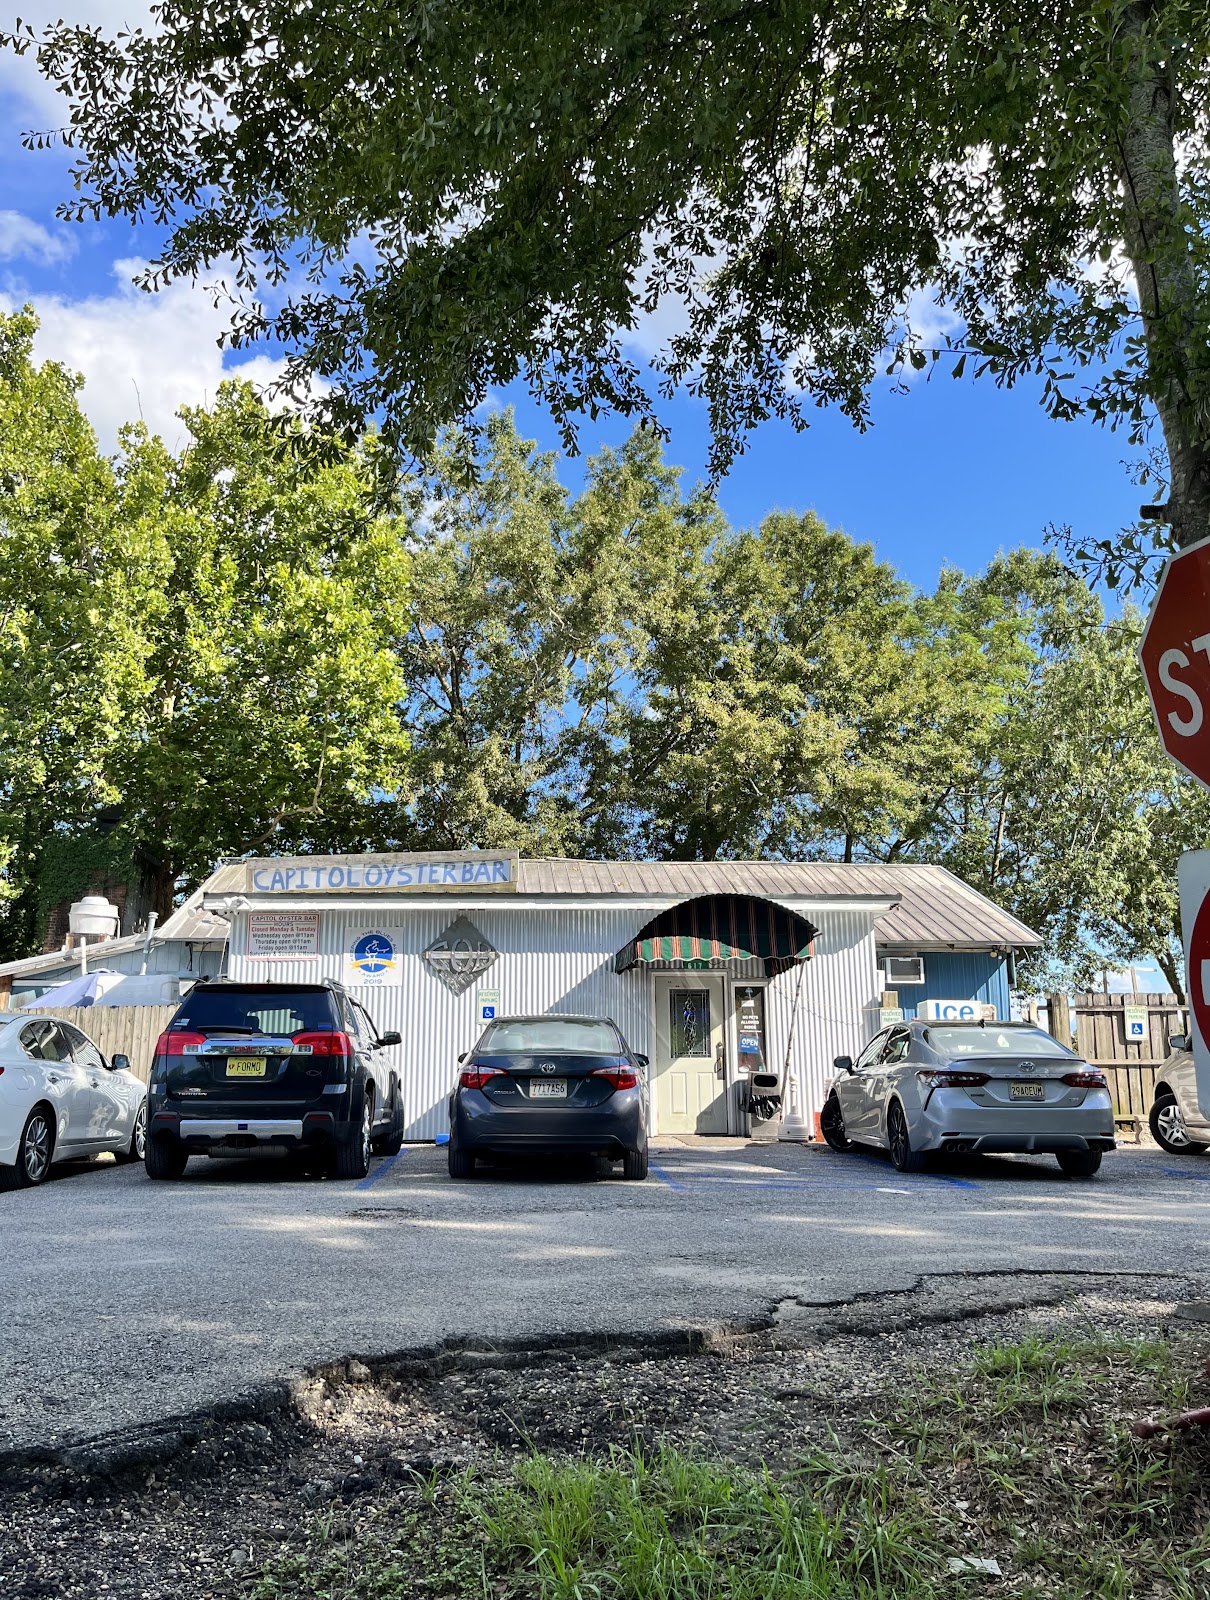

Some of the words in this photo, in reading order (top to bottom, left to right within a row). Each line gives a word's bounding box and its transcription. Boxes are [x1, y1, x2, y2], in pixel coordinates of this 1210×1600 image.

[253, 865, 360, 891] CAPITOL
[364, 862, 457, 887] OYSTER
[461, 860, 509, 883] BAR
[934, 1002, 975, 1020] Ice
[741, 1038, 759, 1047] OPEN
